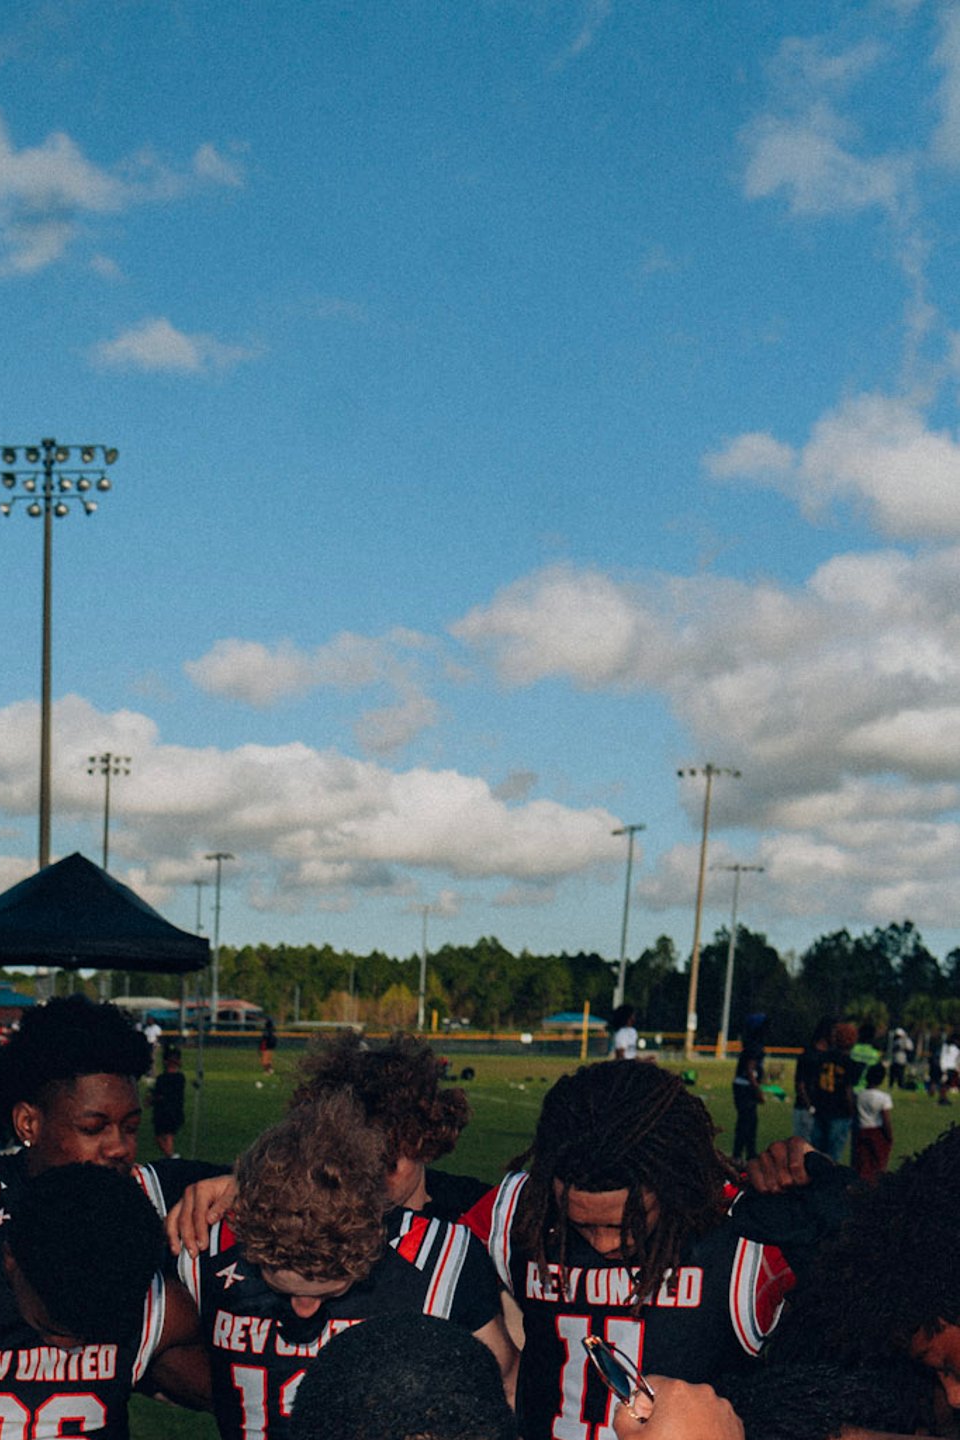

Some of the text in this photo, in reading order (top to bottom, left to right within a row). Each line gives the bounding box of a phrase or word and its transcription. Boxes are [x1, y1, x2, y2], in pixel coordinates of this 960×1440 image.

[586, 1267, 704, 1309] UNED
[213, 1309, 272, 1354] REV
[14, 1343, 118, 1382] UNITED
